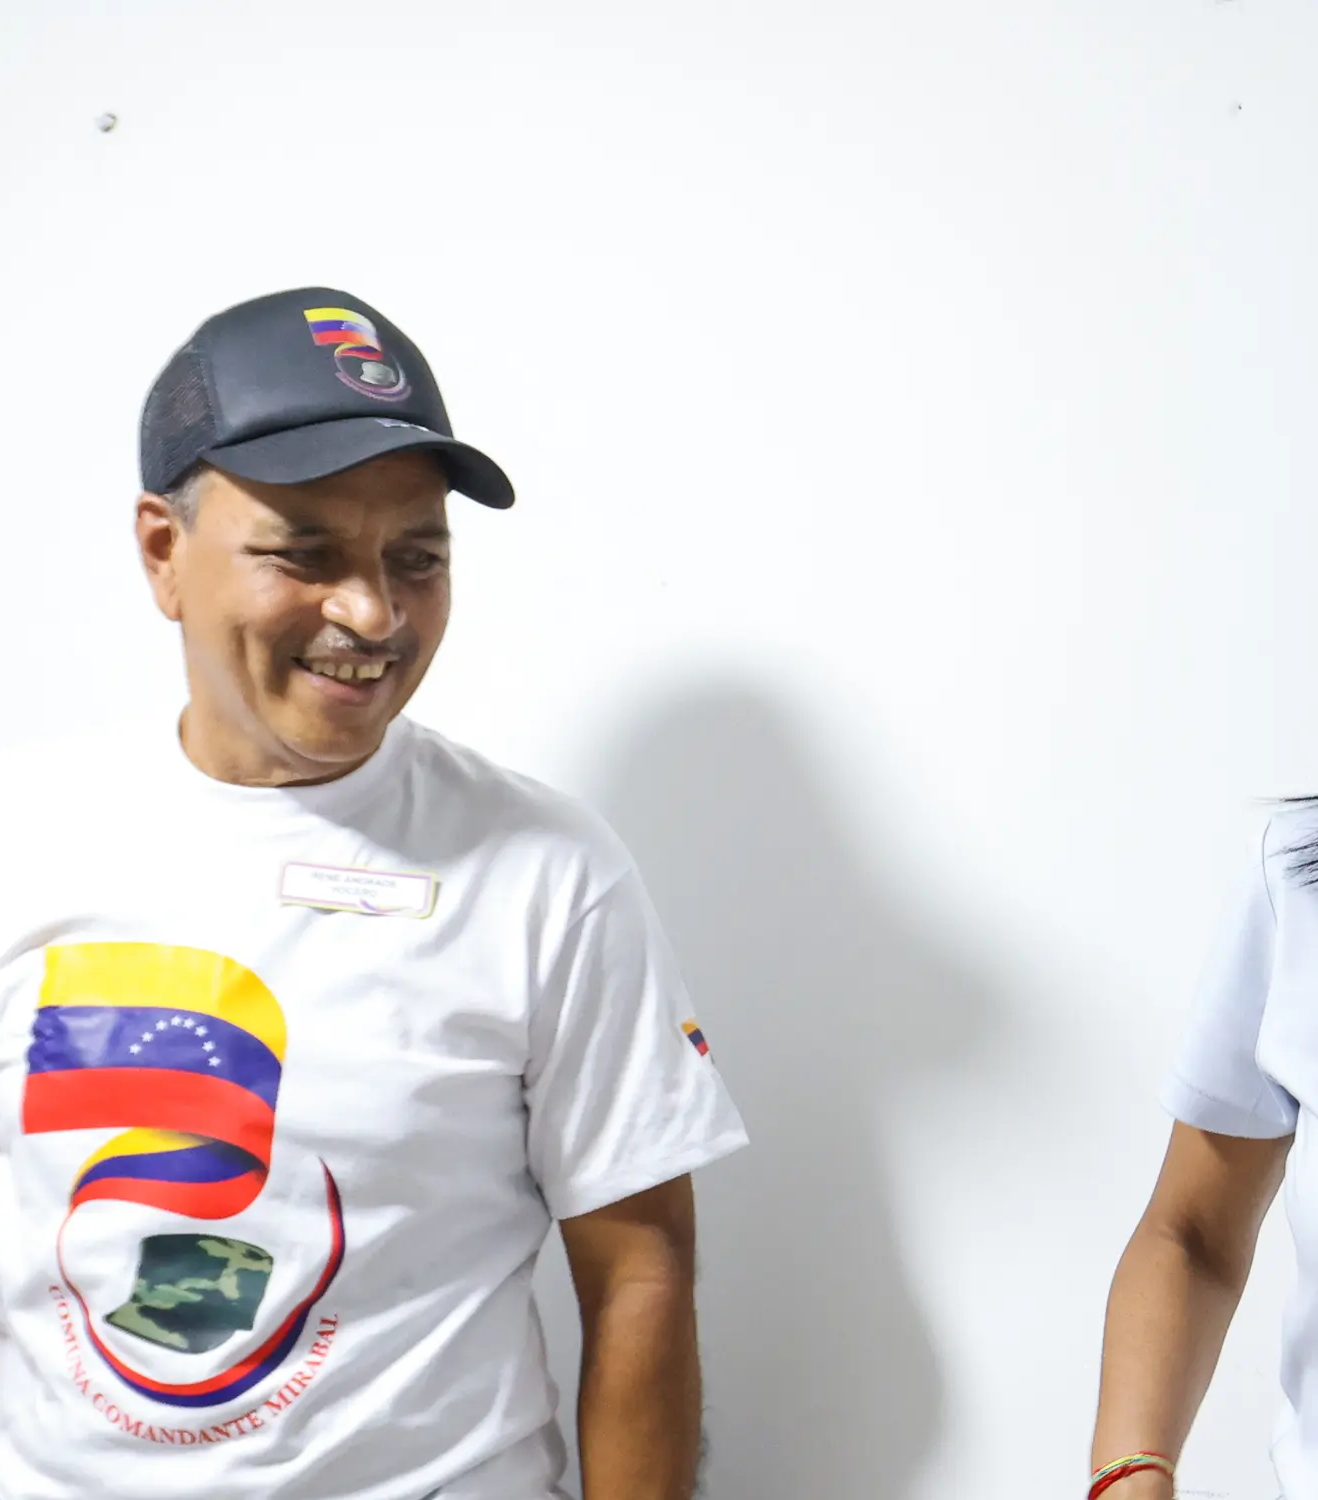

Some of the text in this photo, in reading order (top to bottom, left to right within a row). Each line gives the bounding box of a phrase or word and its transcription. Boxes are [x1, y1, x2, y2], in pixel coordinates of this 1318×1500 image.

[48, 1285, 339, 1446] COMUNA COMANDANTE MIRABAL
